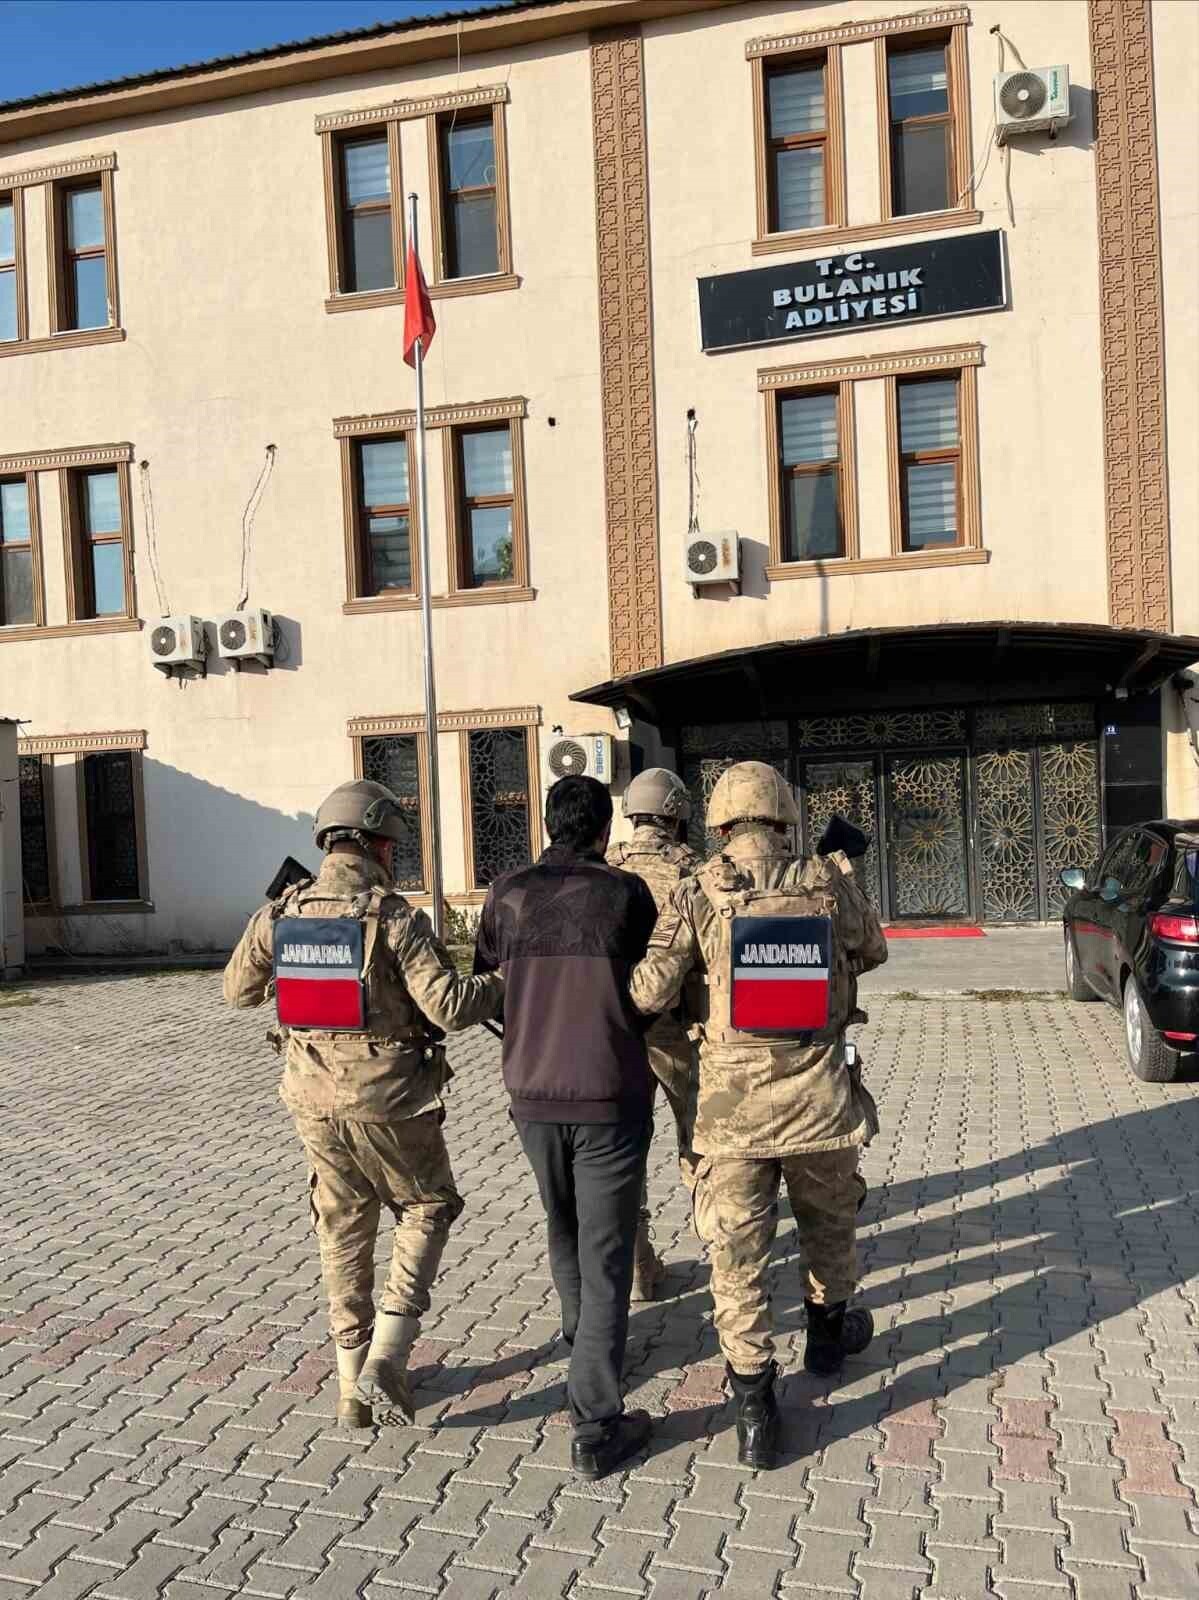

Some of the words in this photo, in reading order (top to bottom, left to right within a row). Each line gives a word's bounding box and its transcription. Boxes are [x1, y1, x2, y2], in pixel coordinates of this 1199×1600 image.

[815, 253, 876, 276] T.C.
[772, 267, 924, 307] BULANIK
[784, 287, 918, 330] ADLİYESİ
[281, 943, 353, 964] JANDARMA
[740, 943, 822, 965] JANDARMA
